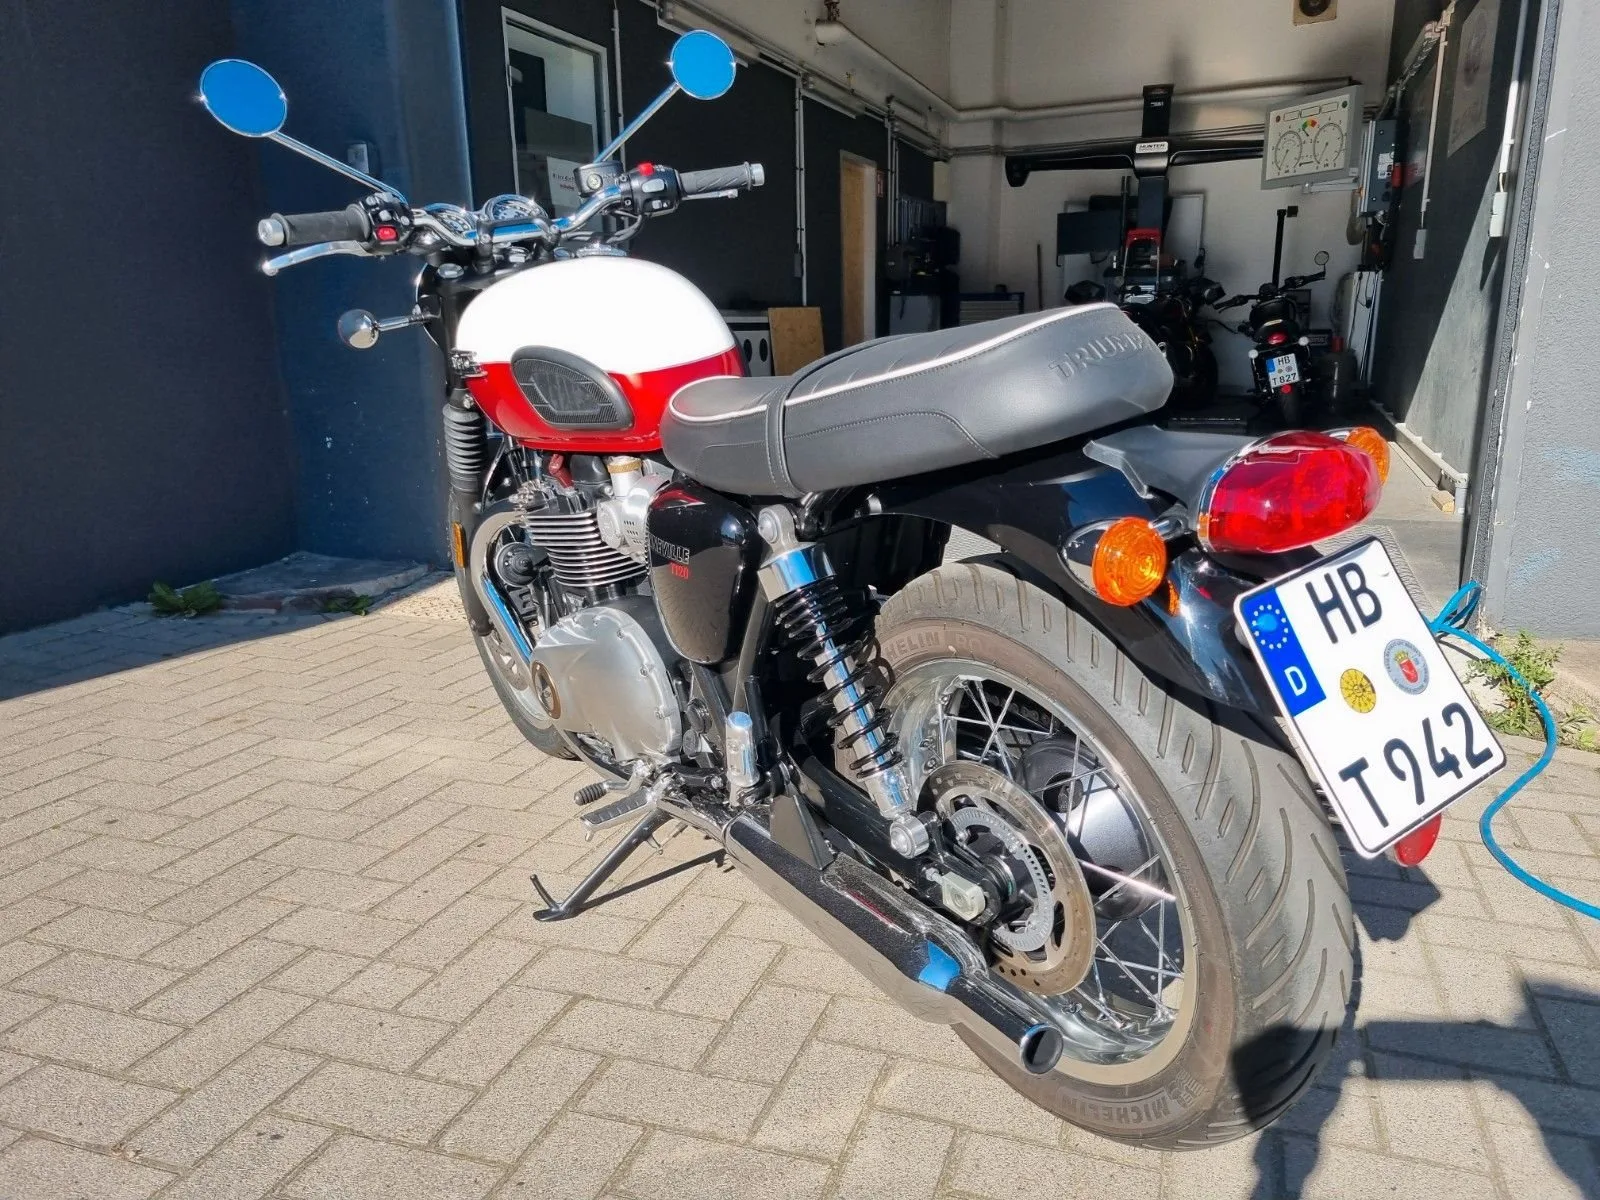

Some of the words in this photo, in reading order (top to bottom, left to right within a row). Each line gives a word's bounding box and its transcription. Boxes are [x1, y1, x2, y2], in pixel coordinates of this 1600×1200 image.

[1047, 332, 1150, 378] TRIUMP
[1277, 355, 1291, 366] HB
[1271, 377, 1278, 386] T
[1279, 372, 1297, 384] 827
[1304, 562, 1383, 644] HB
[883, 631, 940, 662] HELIN
[1284, 665, 1308, 697] D
[1337, 756, 1390, 829] T
[1382, 701, 1494, 806] 942
[1061, 1095, 1171, 1125] MICHELIN
